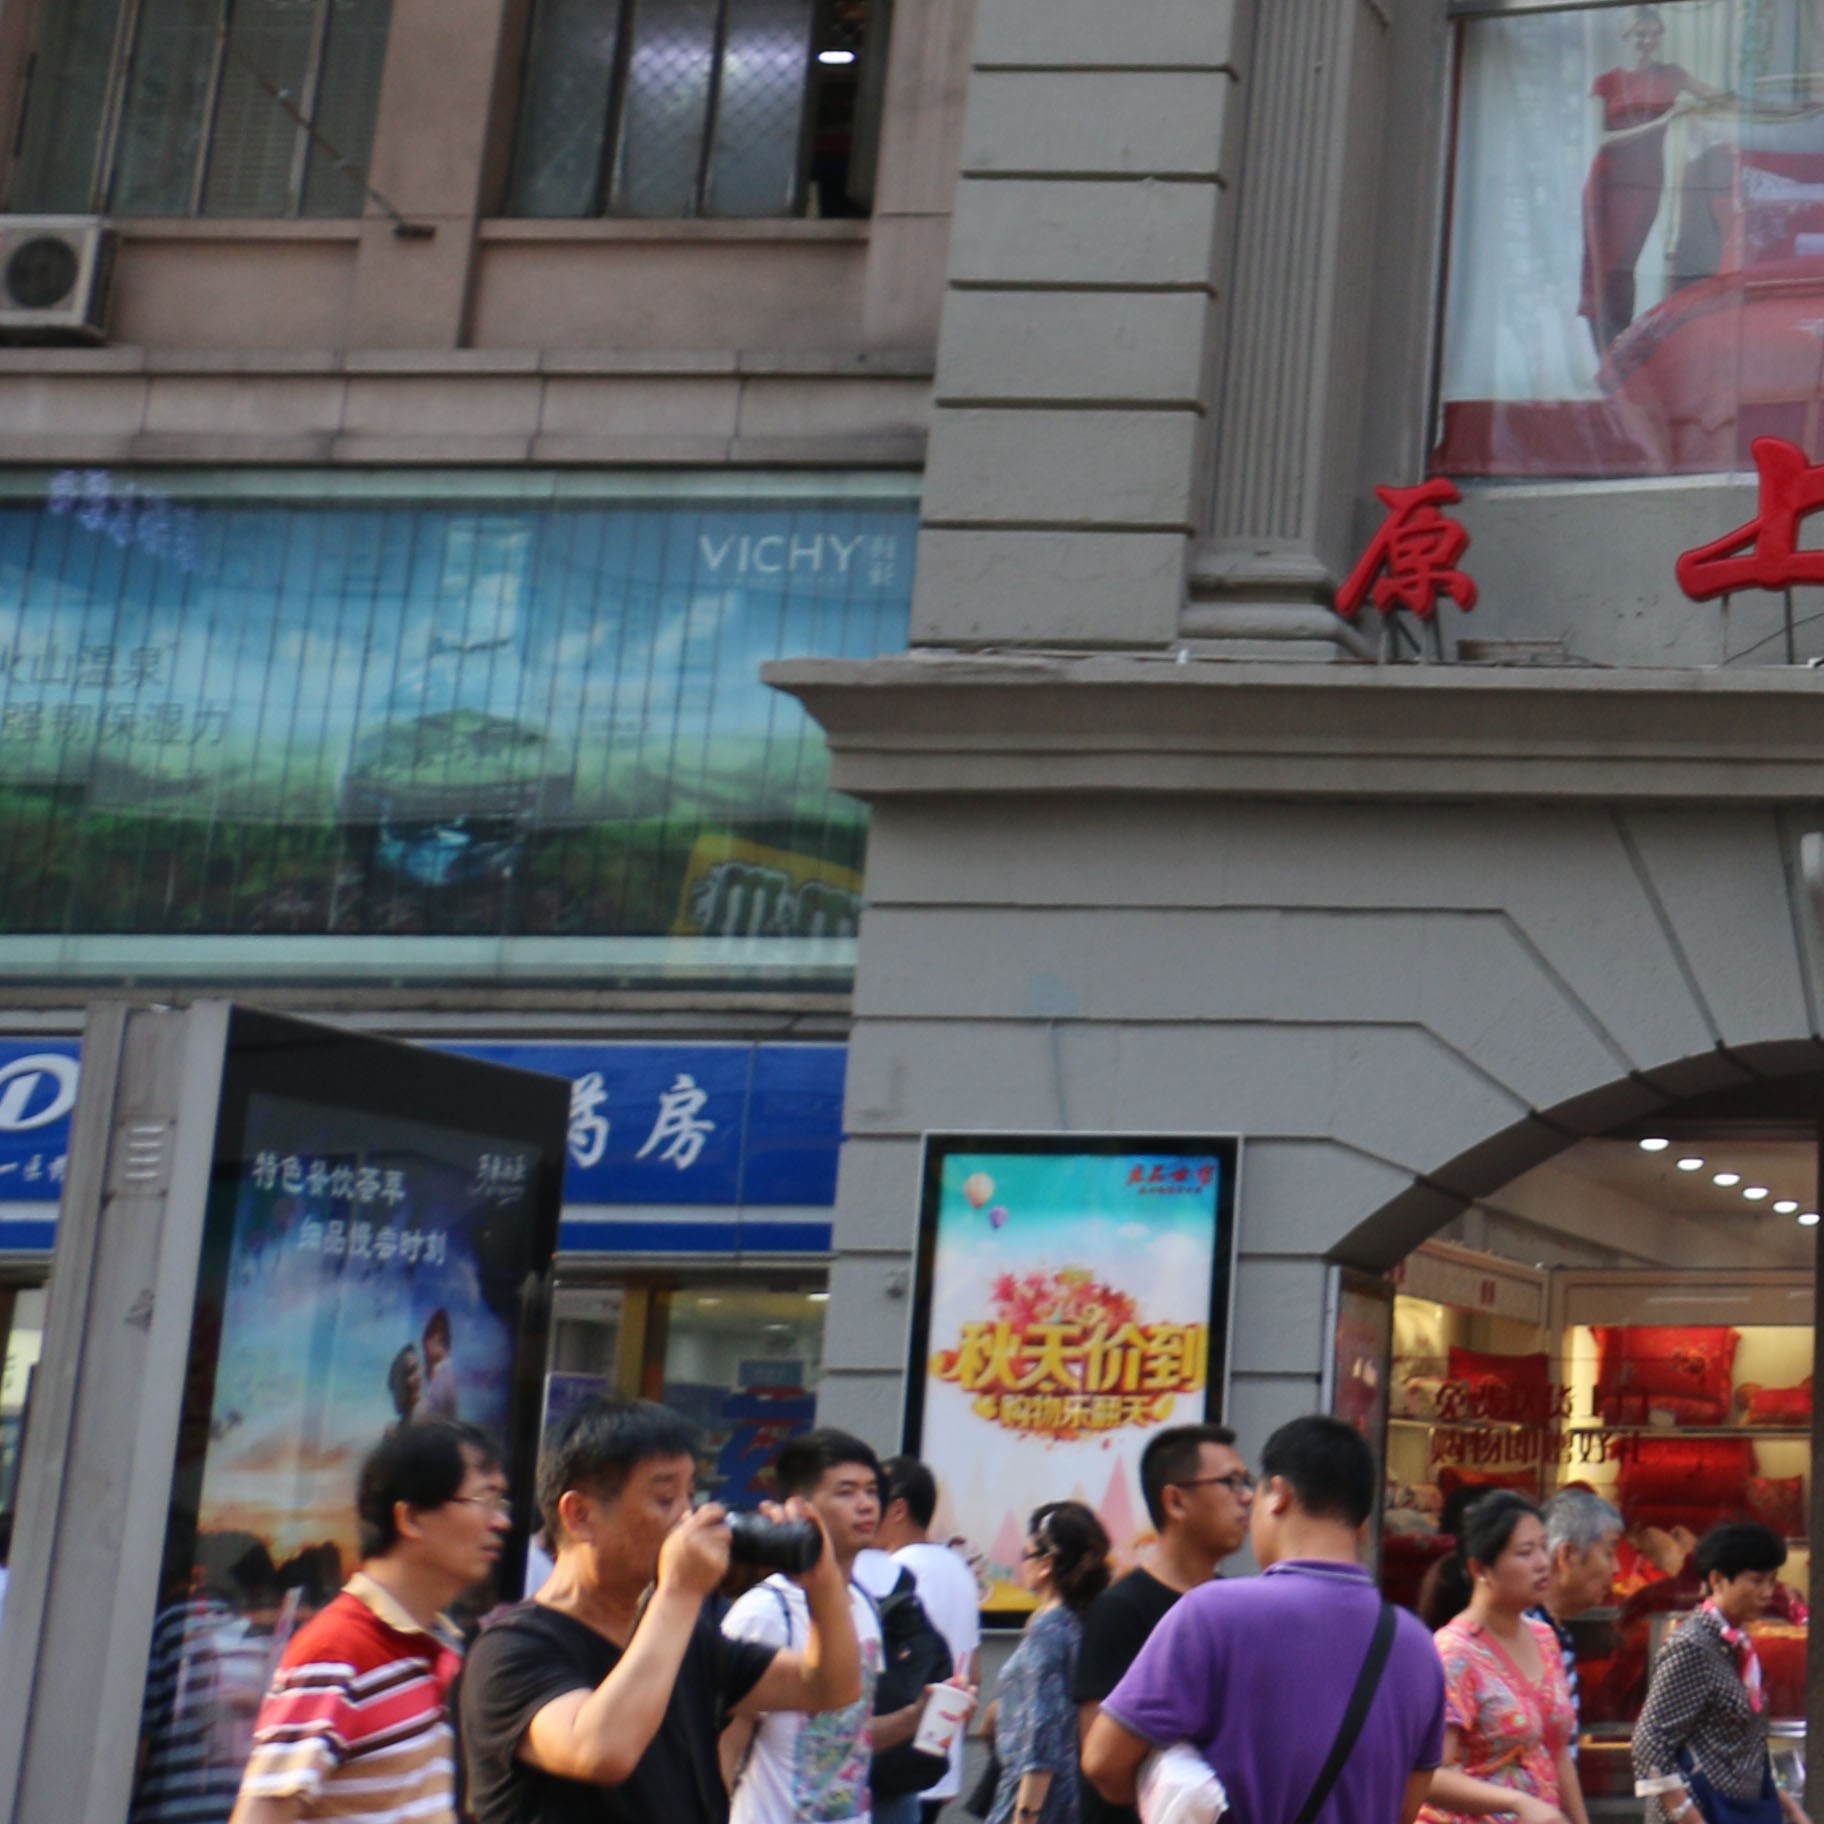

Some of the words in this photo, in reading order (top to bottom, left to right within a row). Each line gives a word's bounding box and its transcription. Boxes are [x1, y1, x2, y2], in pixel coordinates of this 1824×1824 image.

[700, 534, 864, 572] VICHY
[956, 1323, 1207, 1393] 秋天价到
